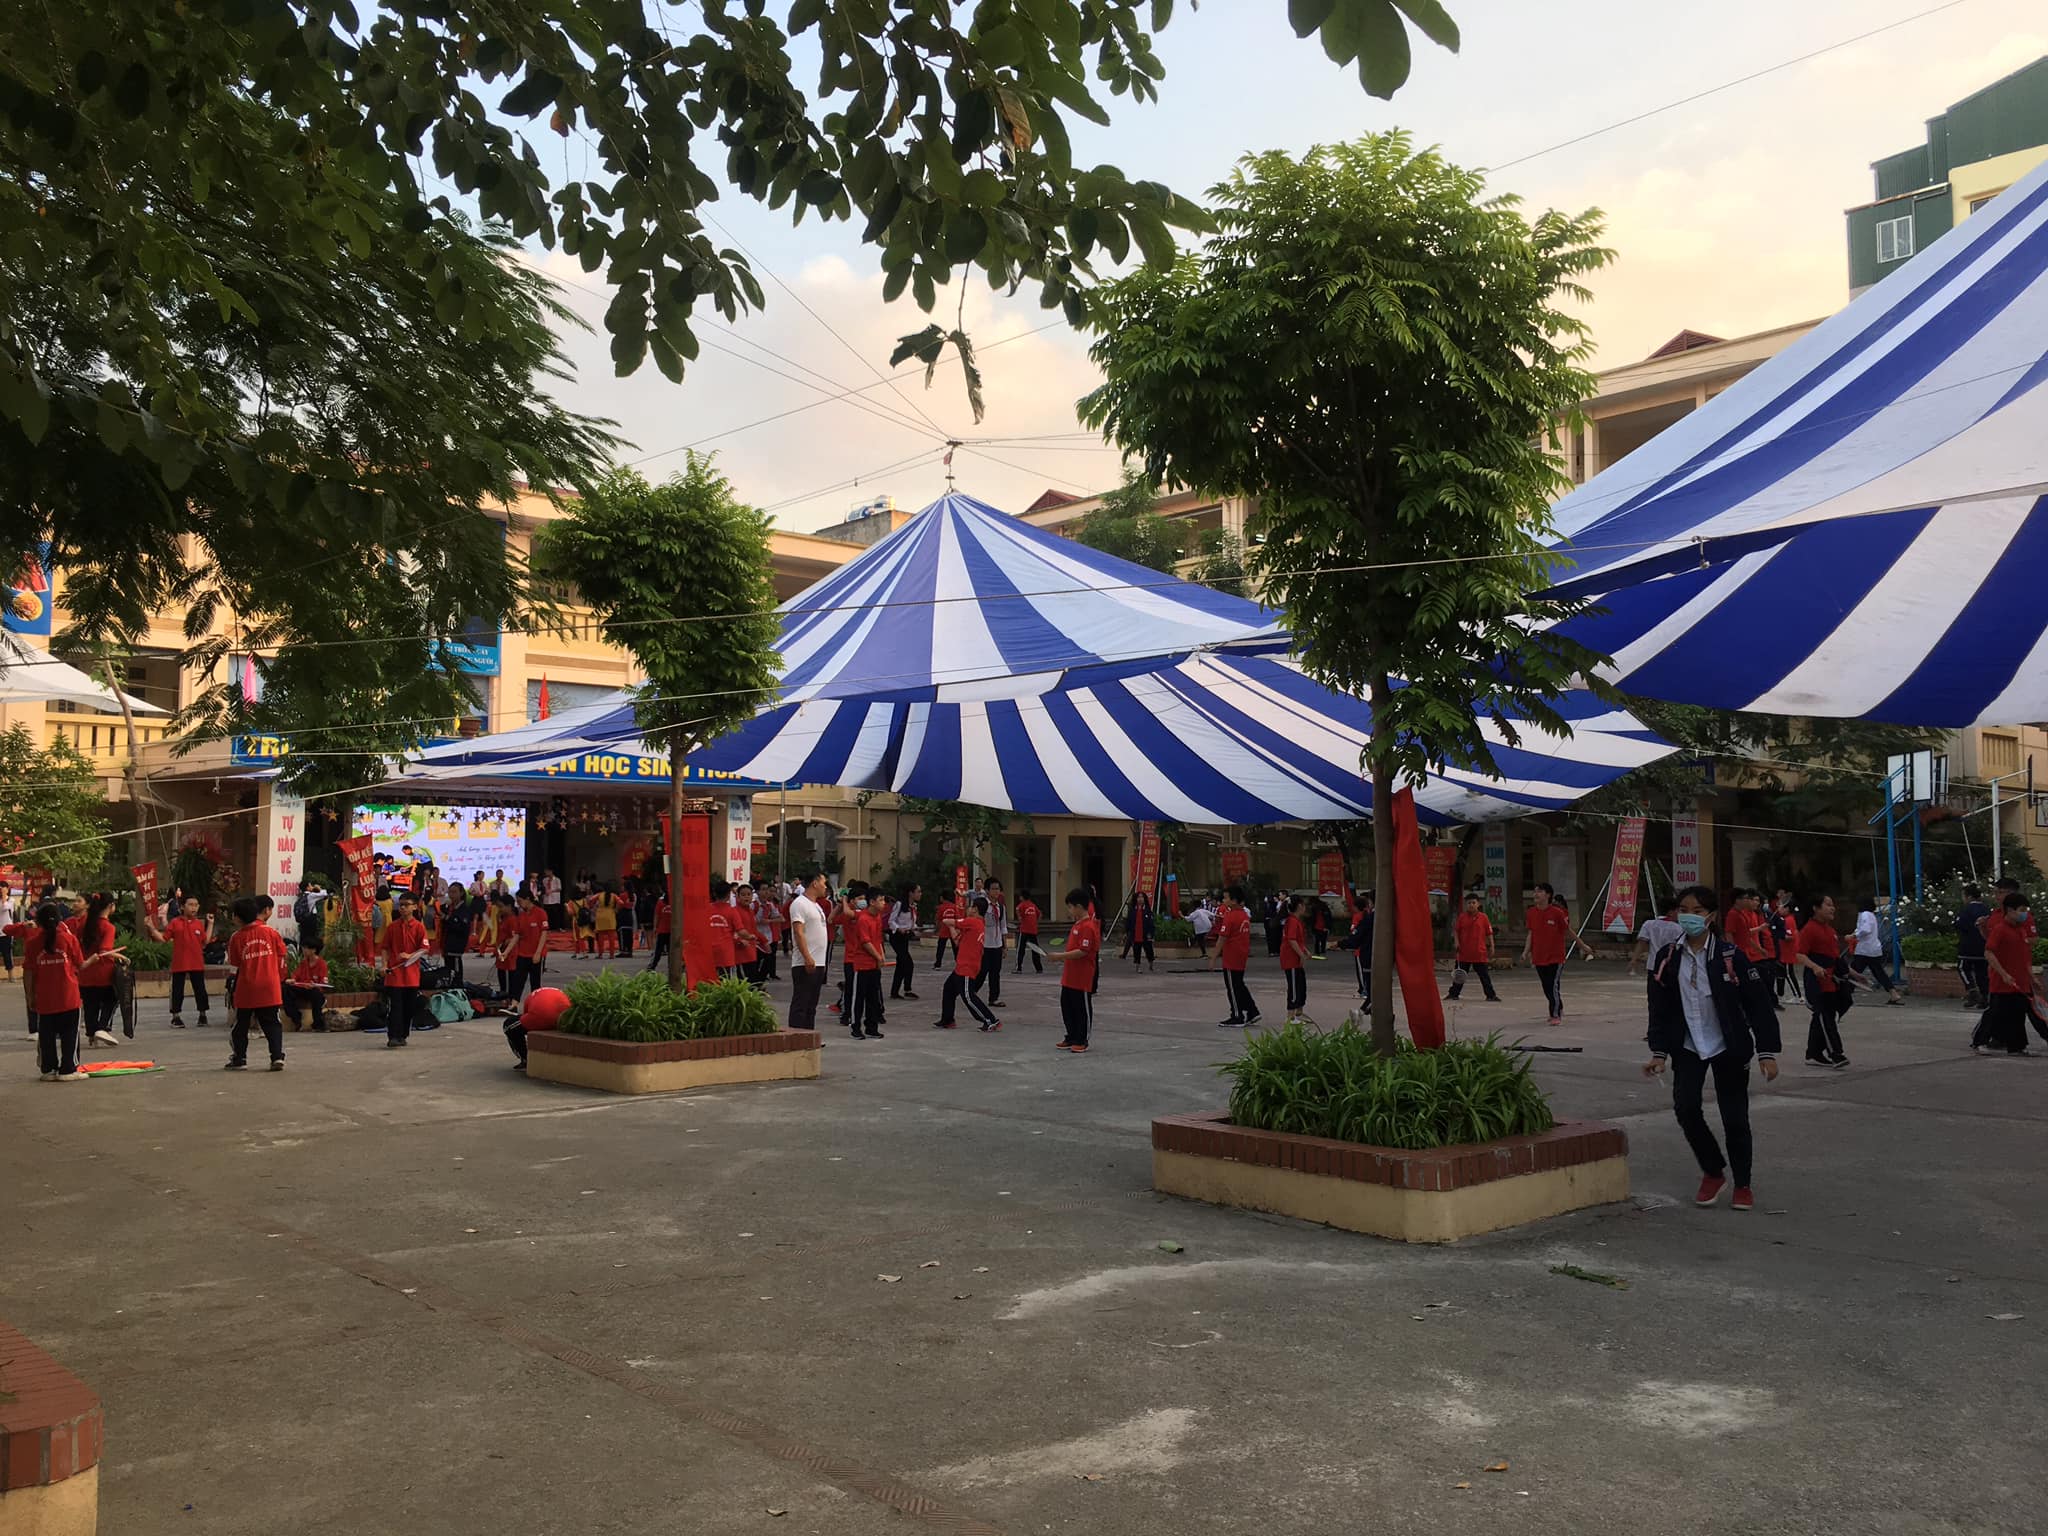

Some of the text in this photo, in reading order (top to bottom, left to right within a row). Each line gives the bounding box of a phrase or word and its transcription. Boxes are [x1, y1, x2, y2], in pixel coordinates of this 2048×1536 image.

[584, 754, 630, 778] HỌC
[277, 834, 296, 852] HÀO
[730, 845, 747, 861] HÀO
[277, 903, 292, 919] EM
